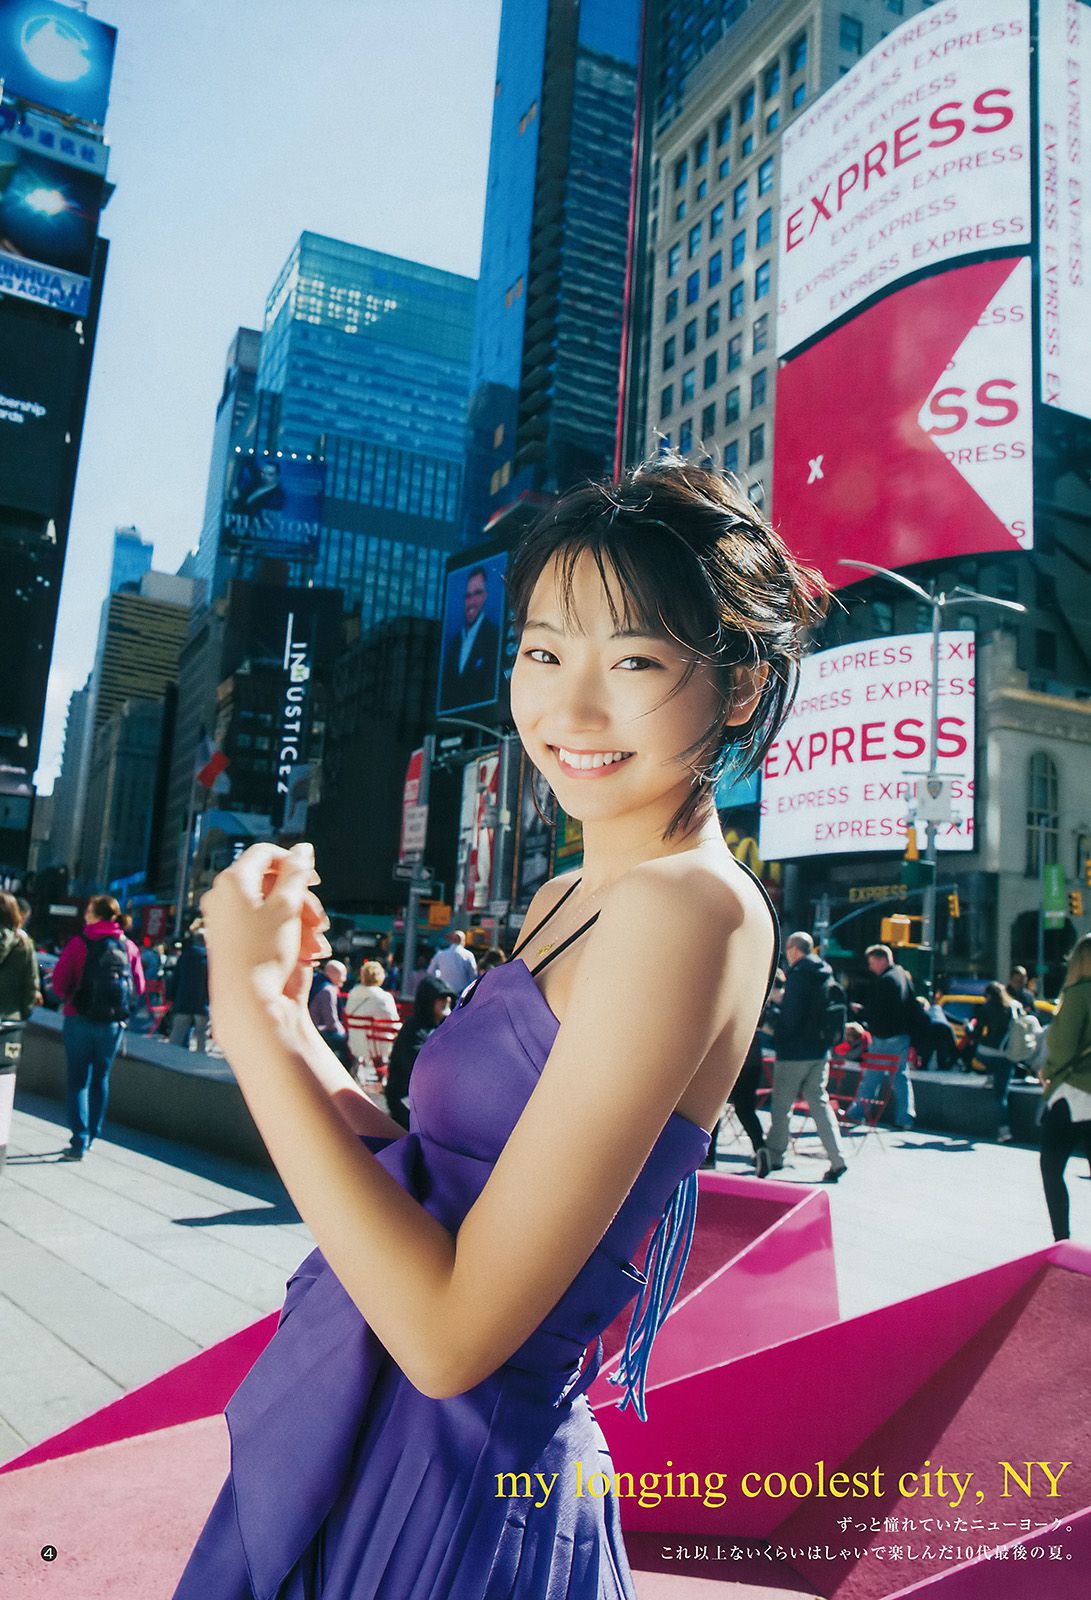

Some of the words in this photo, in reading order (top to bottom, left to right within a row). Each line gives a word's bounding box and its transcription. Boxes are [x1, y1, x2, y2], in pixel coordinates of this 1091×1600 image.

[869, 7, 958, 74] EXPRESS
[914, 20, 1024, 71] EXPRESS
[868, 72, 958, 134] EXPRESS
[786, 89, 1014, 252] EXPRESS
[831, 184, 901, 247] EXPRESS
[912, 145, 1024, 190] EXPRESS
[867, 194, 958, 251] EXPRESS
[829, 252, 901, 311] EXPRESS
[911, 216, 1024, 260] EXPRESS
[819, 646, 913, 679] EXPRESS
[764, 716, 968, 780] EXPRESS
[778, 786, 850, 813] EXPRESS
[815, 817, 909, 841] EXPRESS
